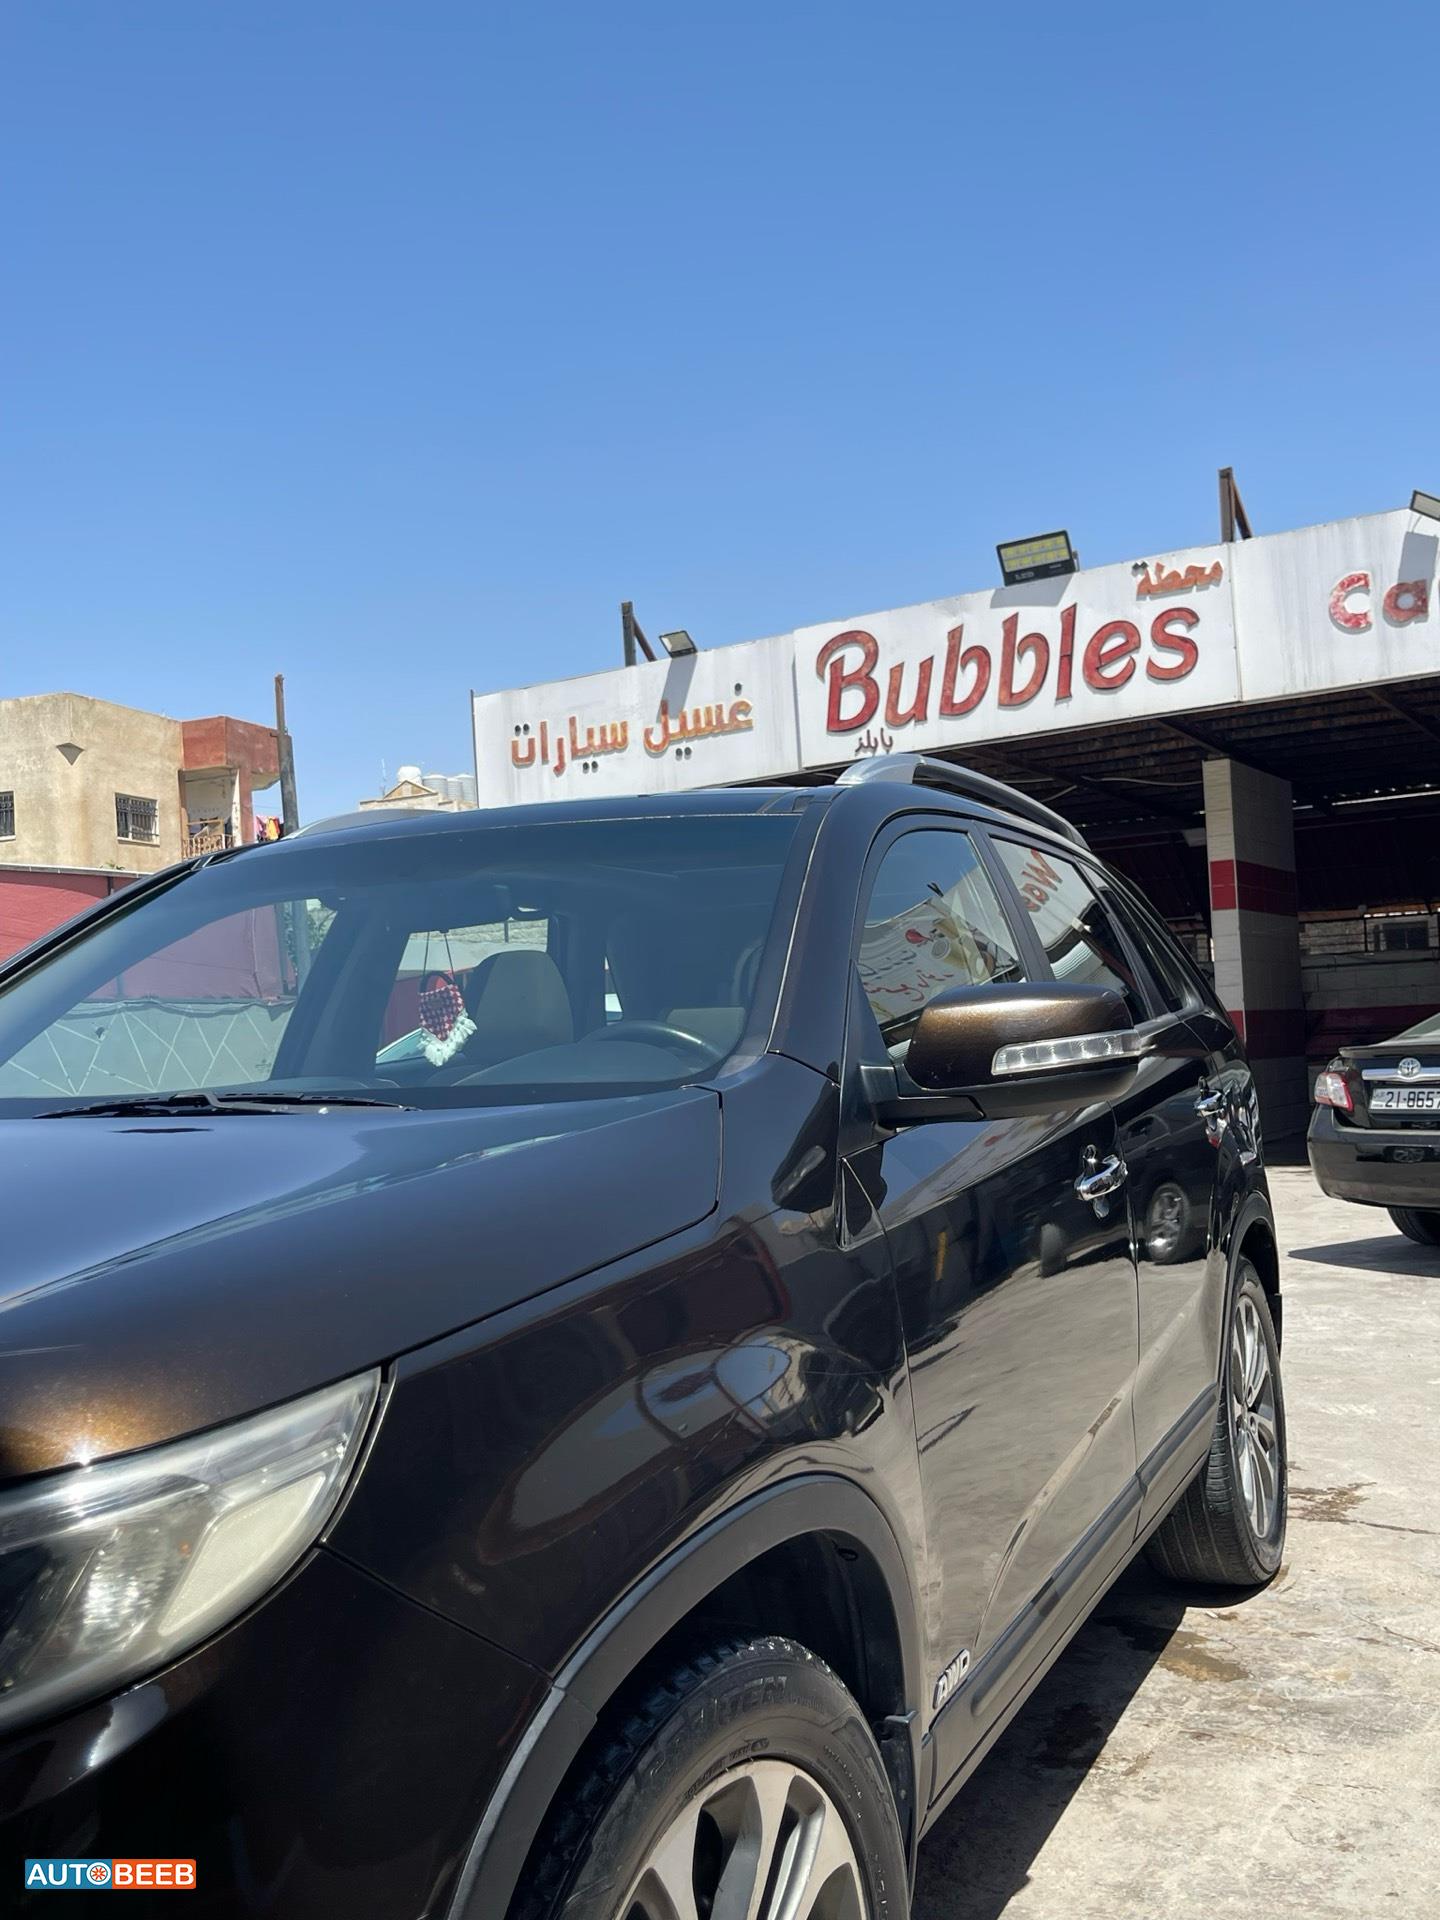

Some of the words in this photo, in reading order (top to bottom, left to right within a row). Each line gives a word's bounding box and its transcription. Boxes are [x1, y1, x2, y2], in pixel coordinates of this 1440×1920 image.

[1132, 561, 1223, 595] محطة
[1330, 573, 1440, 628] Ca
[816, 603, 1200, 732] Bubbles
[511, 716, 629, 774] سيارات
[643, 683, 753, 757] غسيل
[854, 727, 893, 757] بابلز
